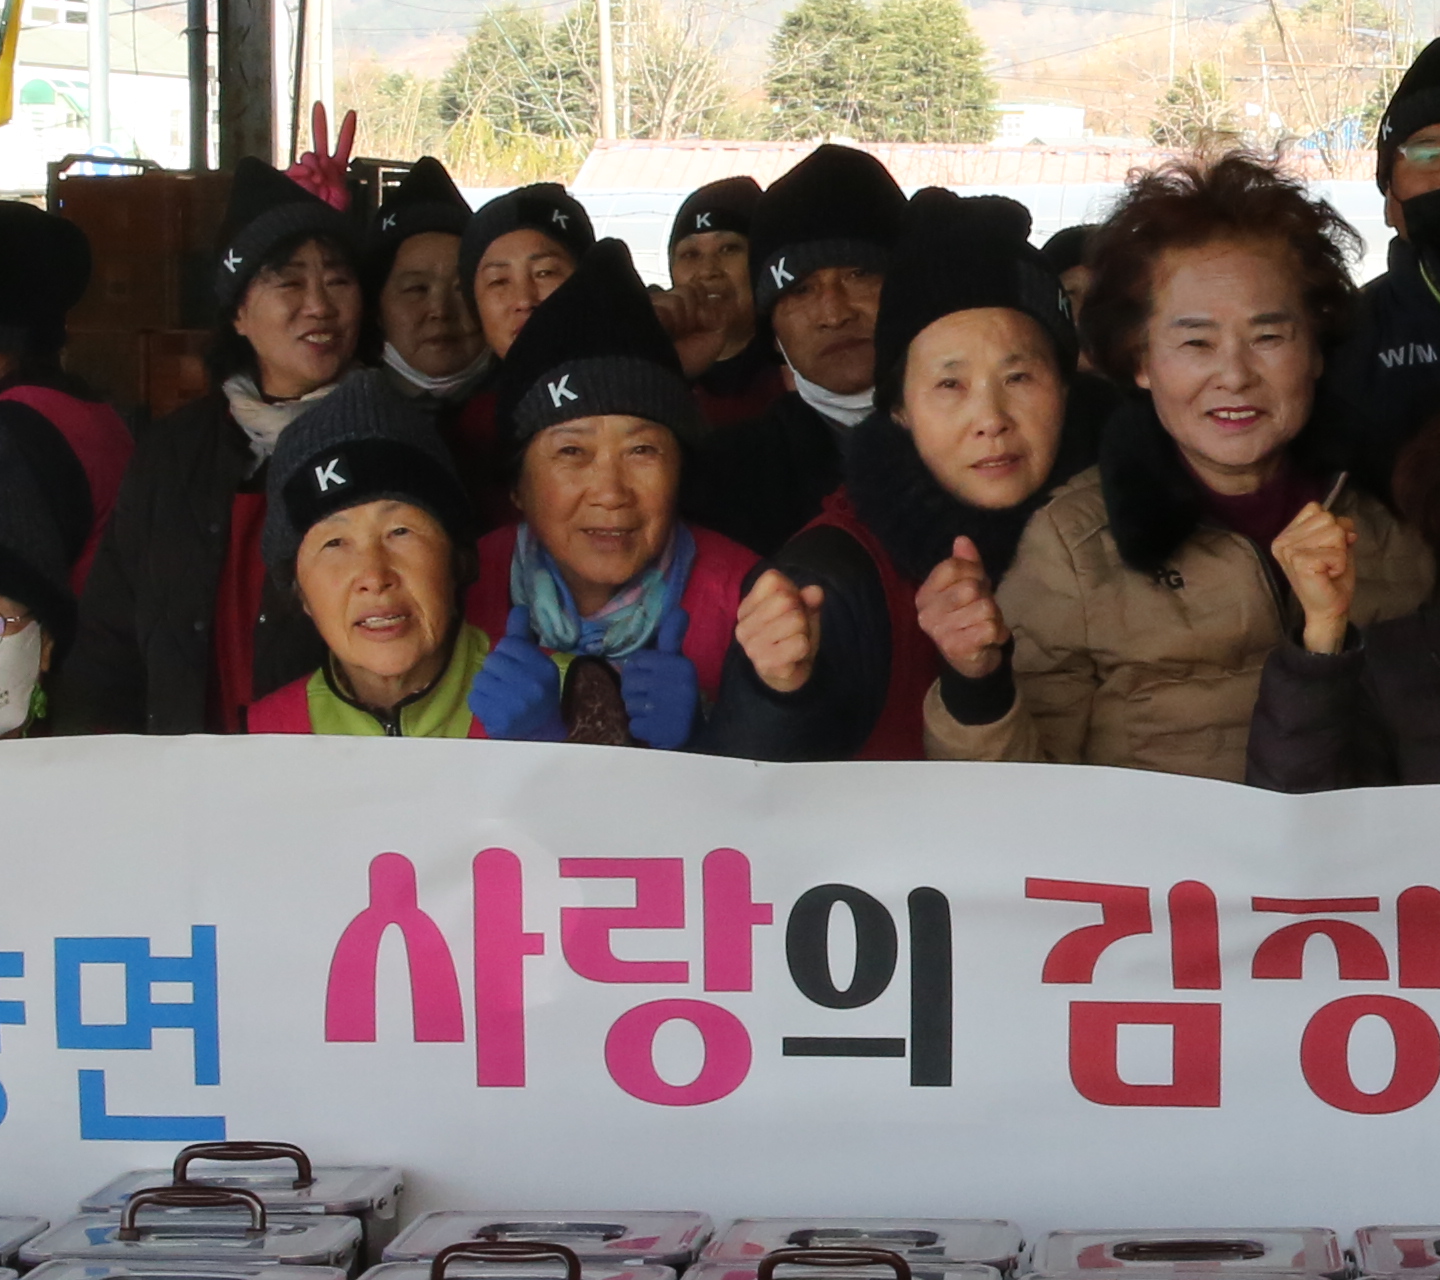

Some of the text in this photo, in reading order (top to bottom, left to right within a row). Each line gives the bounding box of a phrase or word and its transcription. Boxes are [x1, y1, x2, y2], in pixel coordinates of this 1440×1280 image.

[1381, 115, 1392, 140] K
[383, 213, 395, 230] K
[552, 210, 568, 229] K
[697, 213, 711, 228] K
[224, 249, 242, 272] K
[770, 257, 794, 288] K
[1058, 288, 1070, 318] K
[547, 374, 578, 407] K
[315, 459, 346, 491] K
[323, 847, 954, 1107] 사랑의
